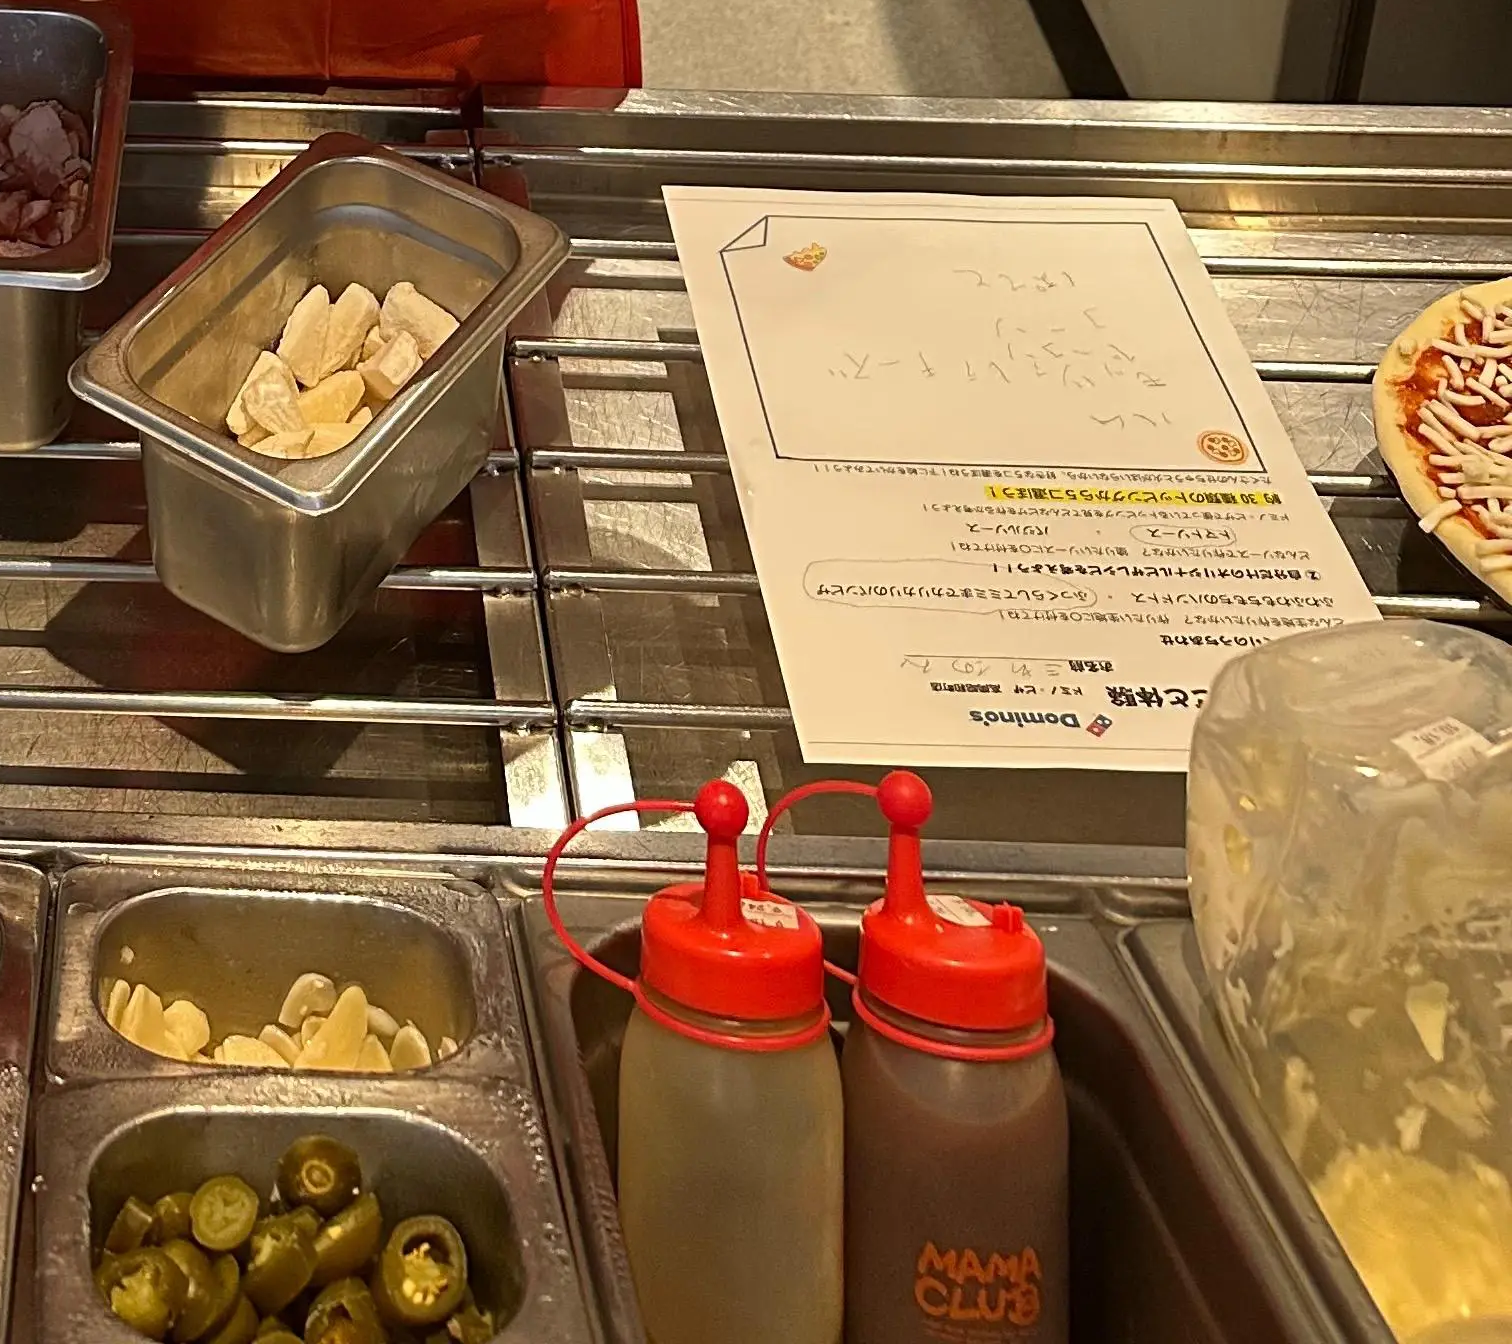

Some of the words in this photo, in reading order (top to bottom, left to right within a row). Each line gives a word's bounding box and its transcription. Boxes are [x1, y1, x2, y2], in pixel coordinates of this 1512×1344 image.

[965, 522, 1049, 535] バジルソース
[1145, 527, 1231, 540] トマトソース
[816, 584, 1088, 602] ふっくらしてミミまでカリカリのパンピザ
[1130, 592, 1334, 608] ふわふわもちもちのハンドトス
[1159, 634, 1270, 647] りのうちあわせ
[1068, 659, 1114, 673] お名前
[968, 710, 1081, 729] Domino's
[917, 1240, 1043, 1285] MAMA
[914, 1275, 1041, 1326] CLUB
